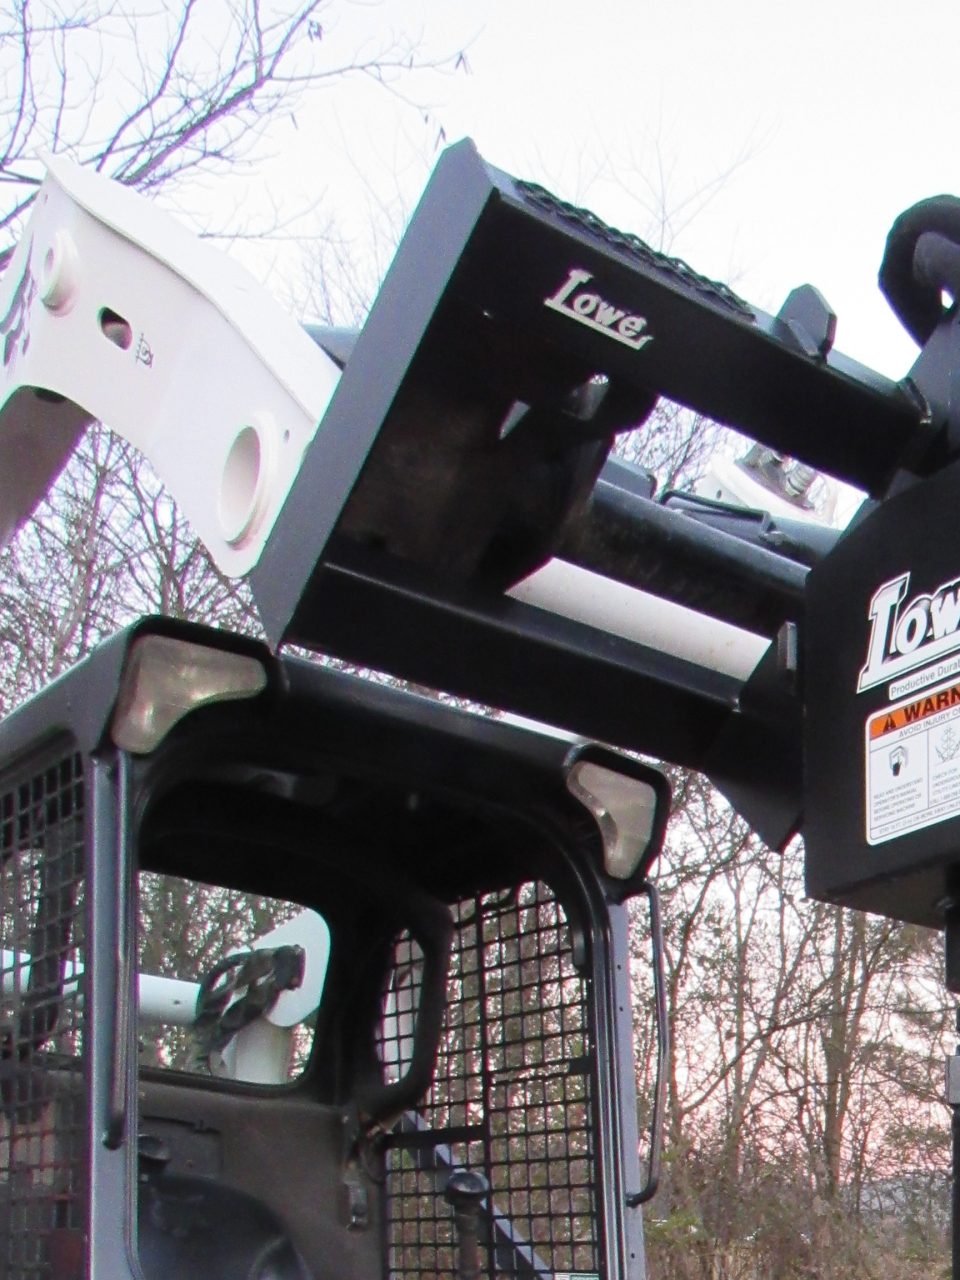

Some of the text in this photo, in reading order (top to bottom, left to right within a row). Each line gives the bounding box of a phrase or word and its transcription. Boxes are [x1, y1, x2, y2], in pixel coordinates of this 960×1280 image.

[544, 269, 653, 350] Lowe
[891, 671, 935, 697] Productive
[899, 723, 922, 738] AVOID
[923, 711, 950, 729] INJURY
